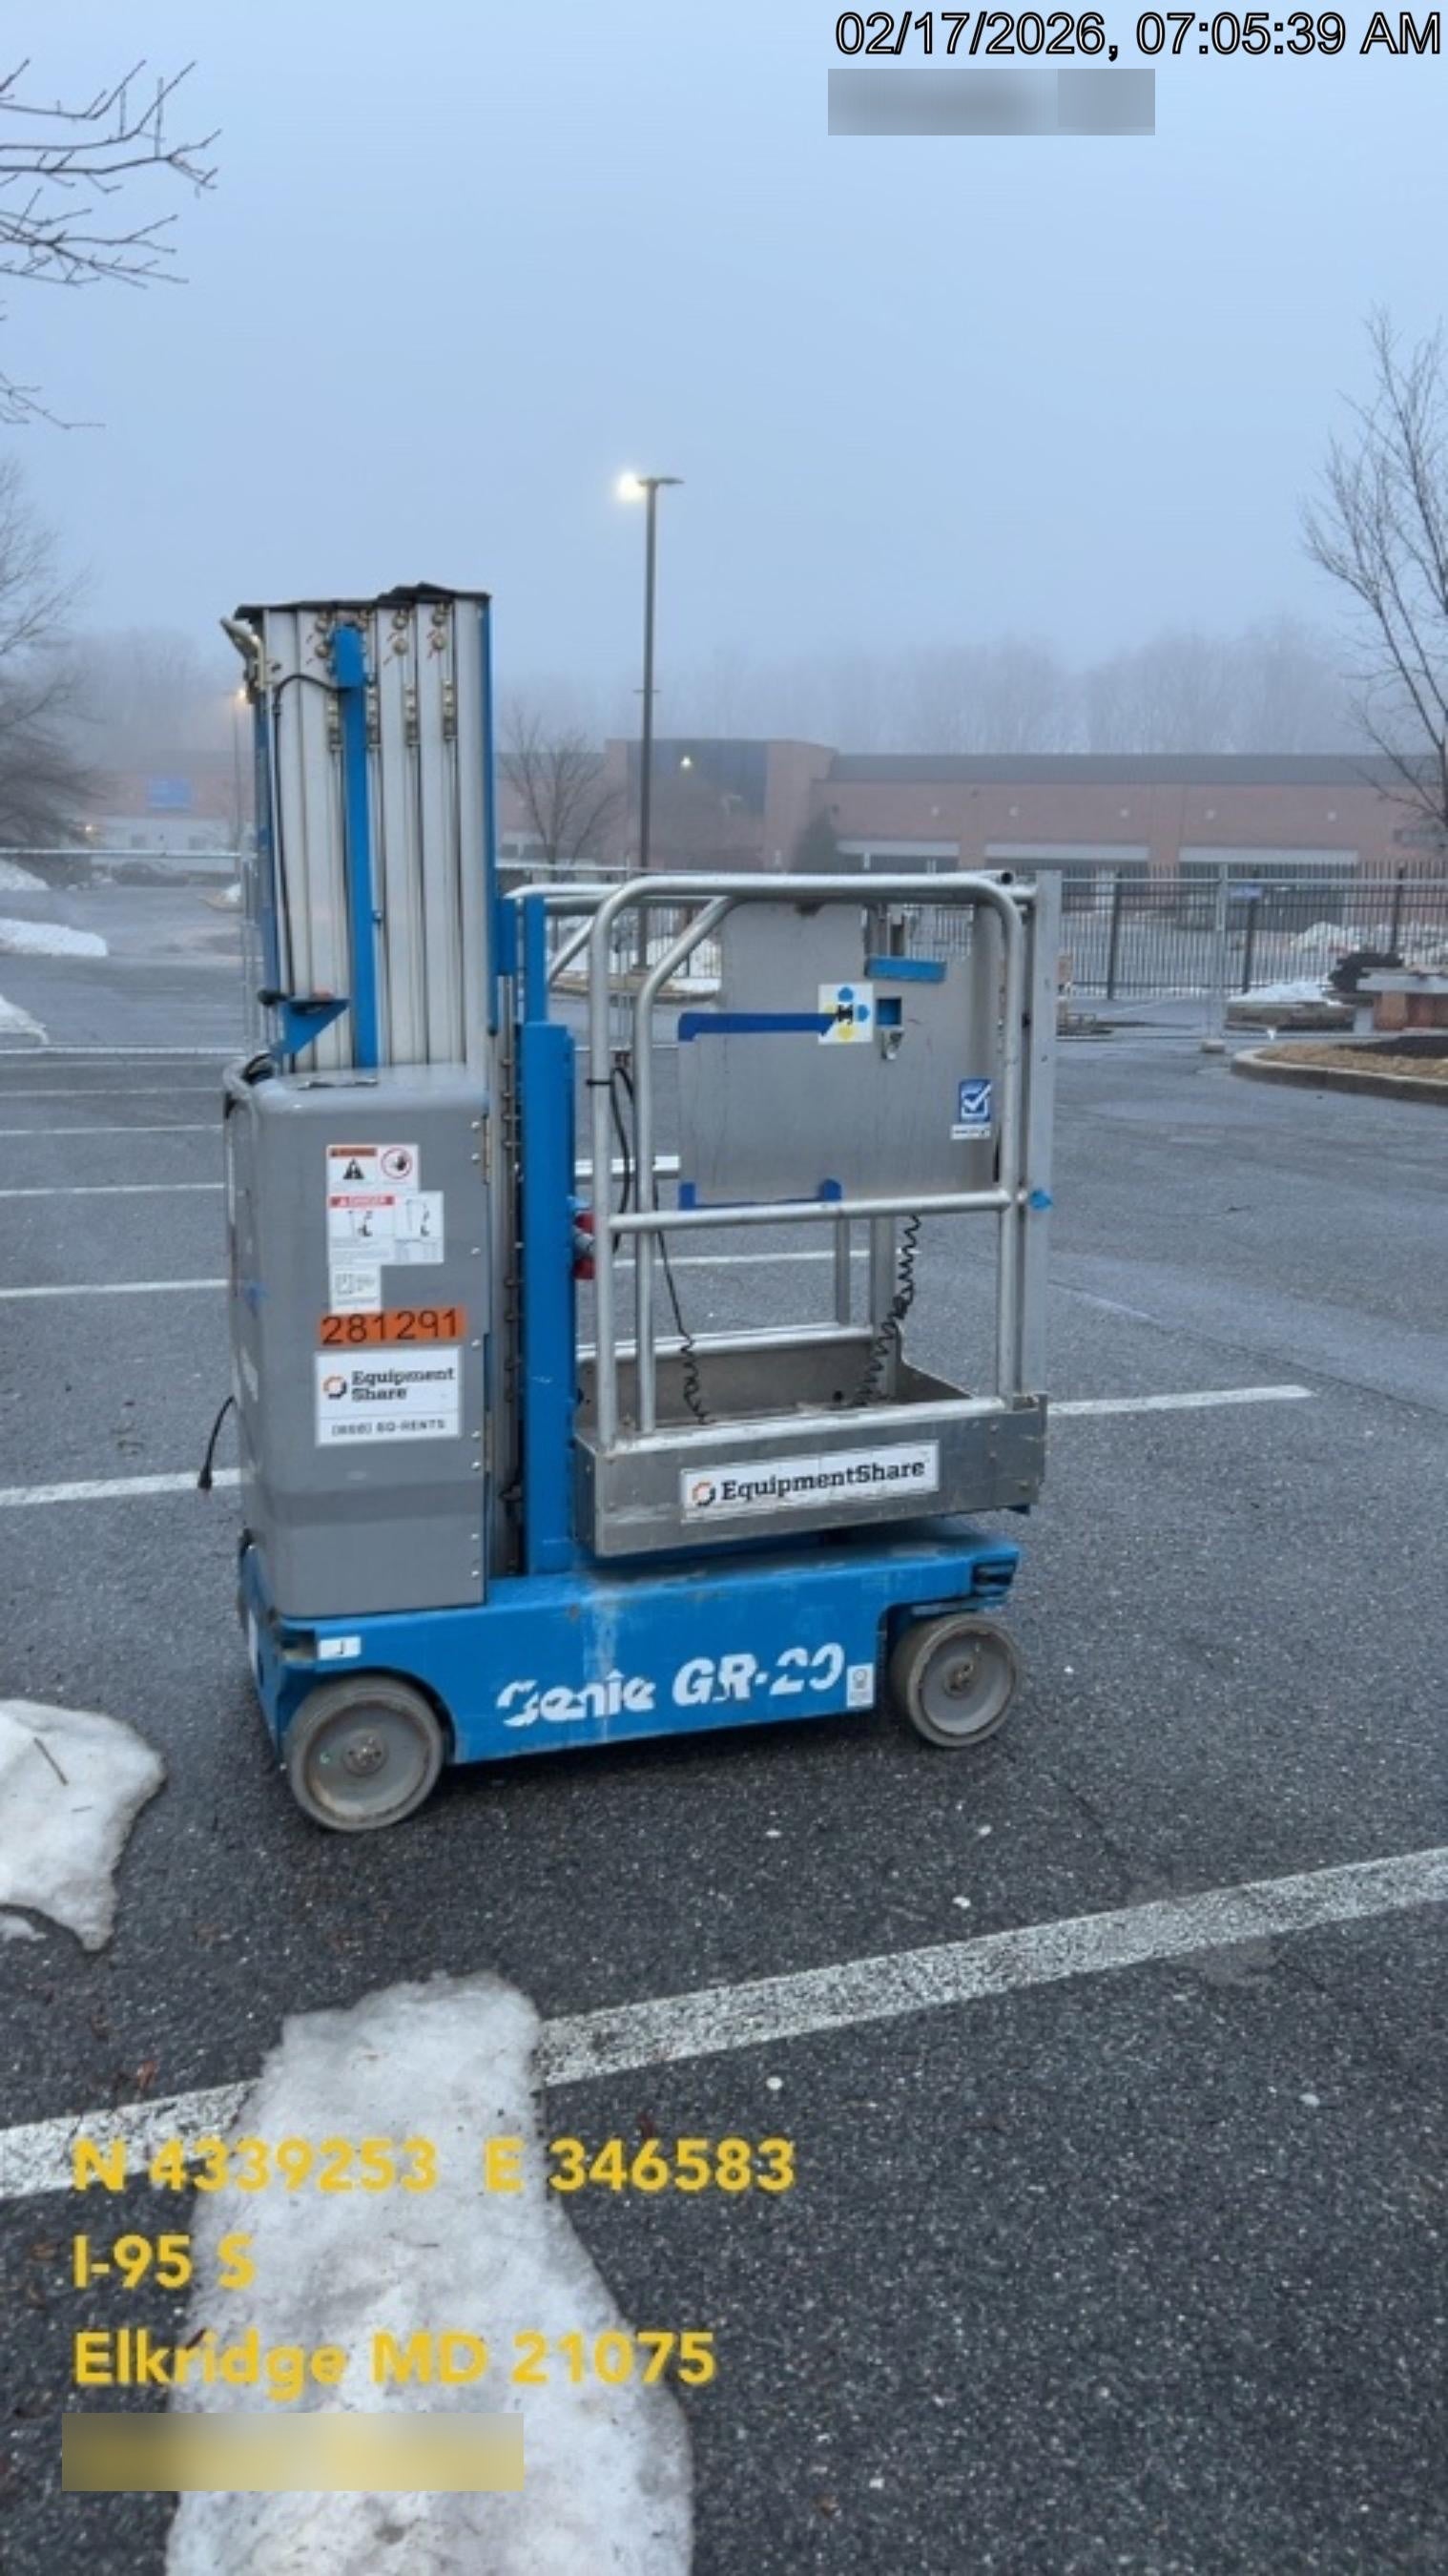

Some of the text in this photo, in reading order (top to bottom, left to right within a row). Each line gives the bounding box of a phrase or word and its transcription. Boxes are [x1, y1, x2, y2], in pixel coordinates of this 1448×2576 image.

[322, 1308, 455, 1345] 281291
[351, 1367, 455, 1385] Equipment
[351, 1387, 406, 1402] Share
[721, 1461, 925, 1502] EquipmentShare
[672, 1642, 846, 1705] GR-20
